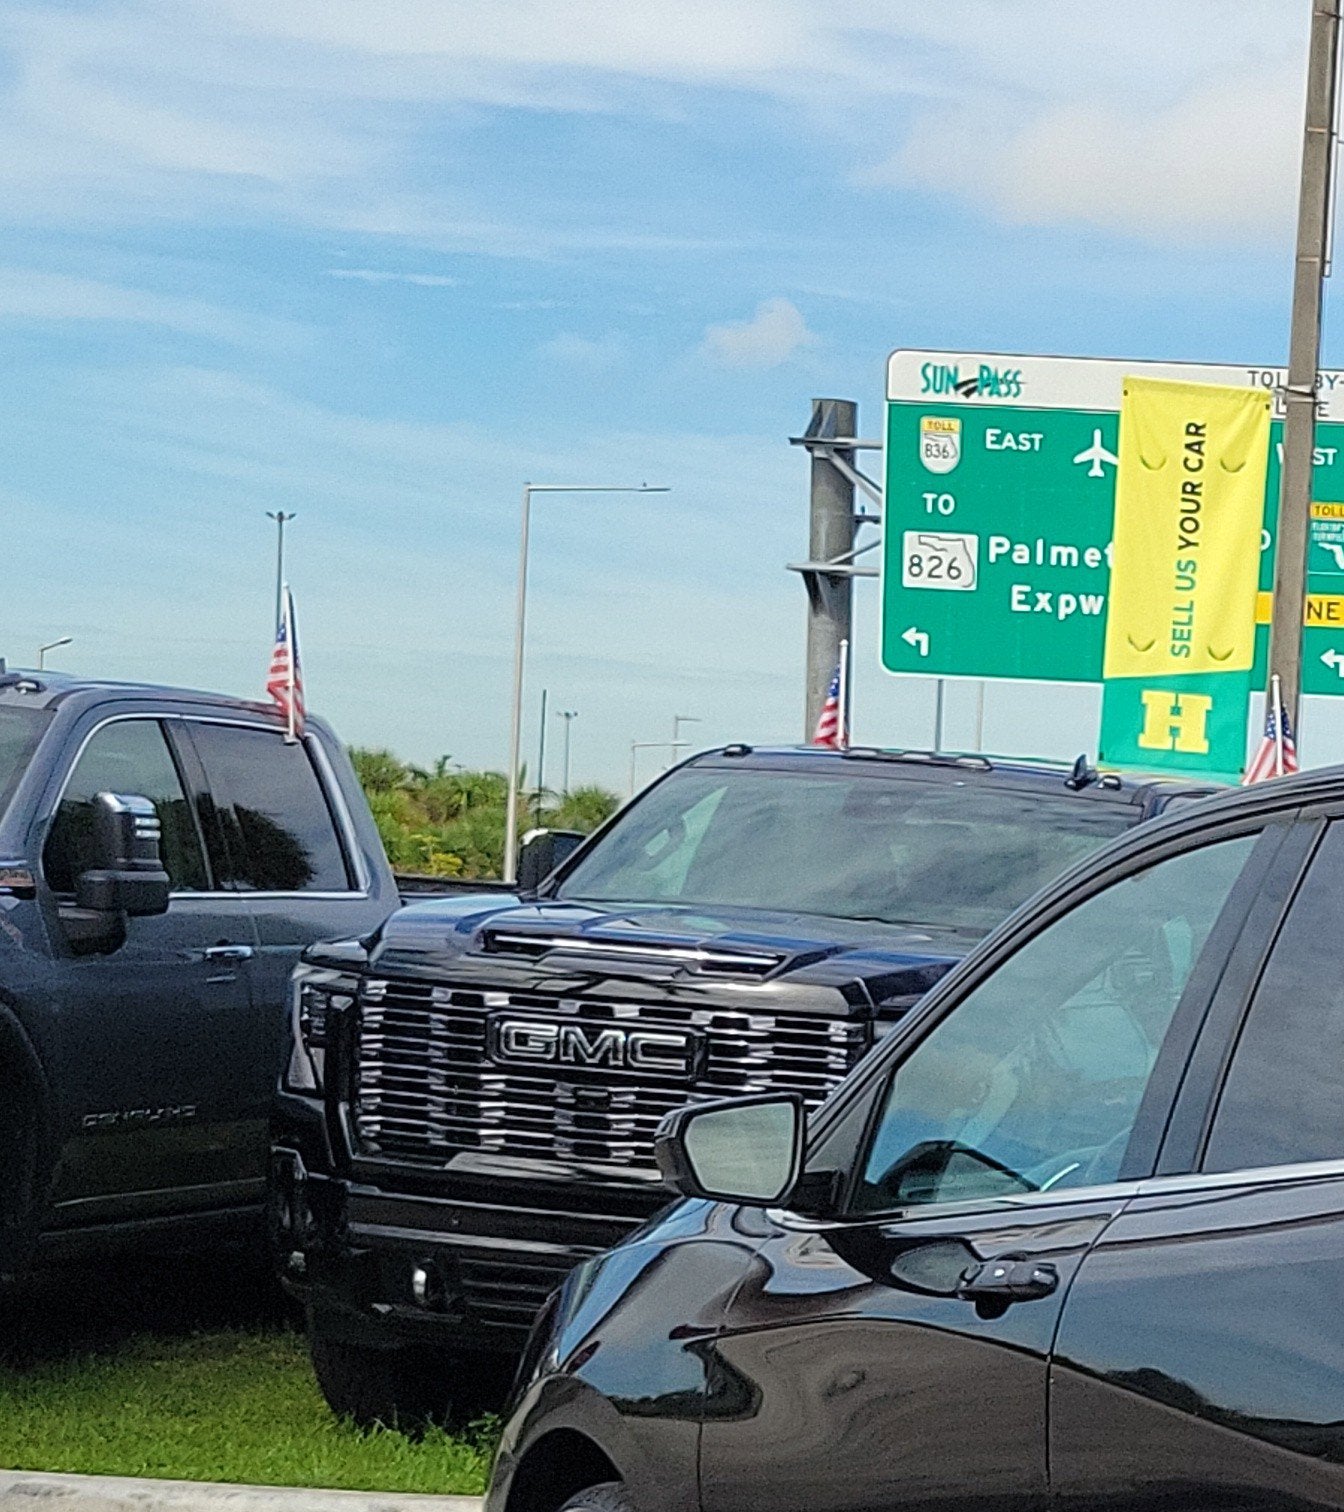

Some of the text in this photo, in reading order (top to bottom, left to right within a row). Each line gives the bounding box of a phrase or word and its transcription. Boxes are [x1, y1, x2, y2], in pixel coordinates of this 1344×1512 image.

[927, 420, 955, 432] TOLL
[985, 428, 1044, 452] EAST
[925, 443, 950, 460] 836
[922, 492, 956, 516] TO
[988, 535, 1114, 568] Palmet
[1171, 421, 1208, 659] SELL US YOUR CAR
[908, 553, 963, 580] 826
[1010, 584, 1105, 621] Expw
[1138, 689, 1213, 755] H
[500, 1021, 687, 1071] GMC
